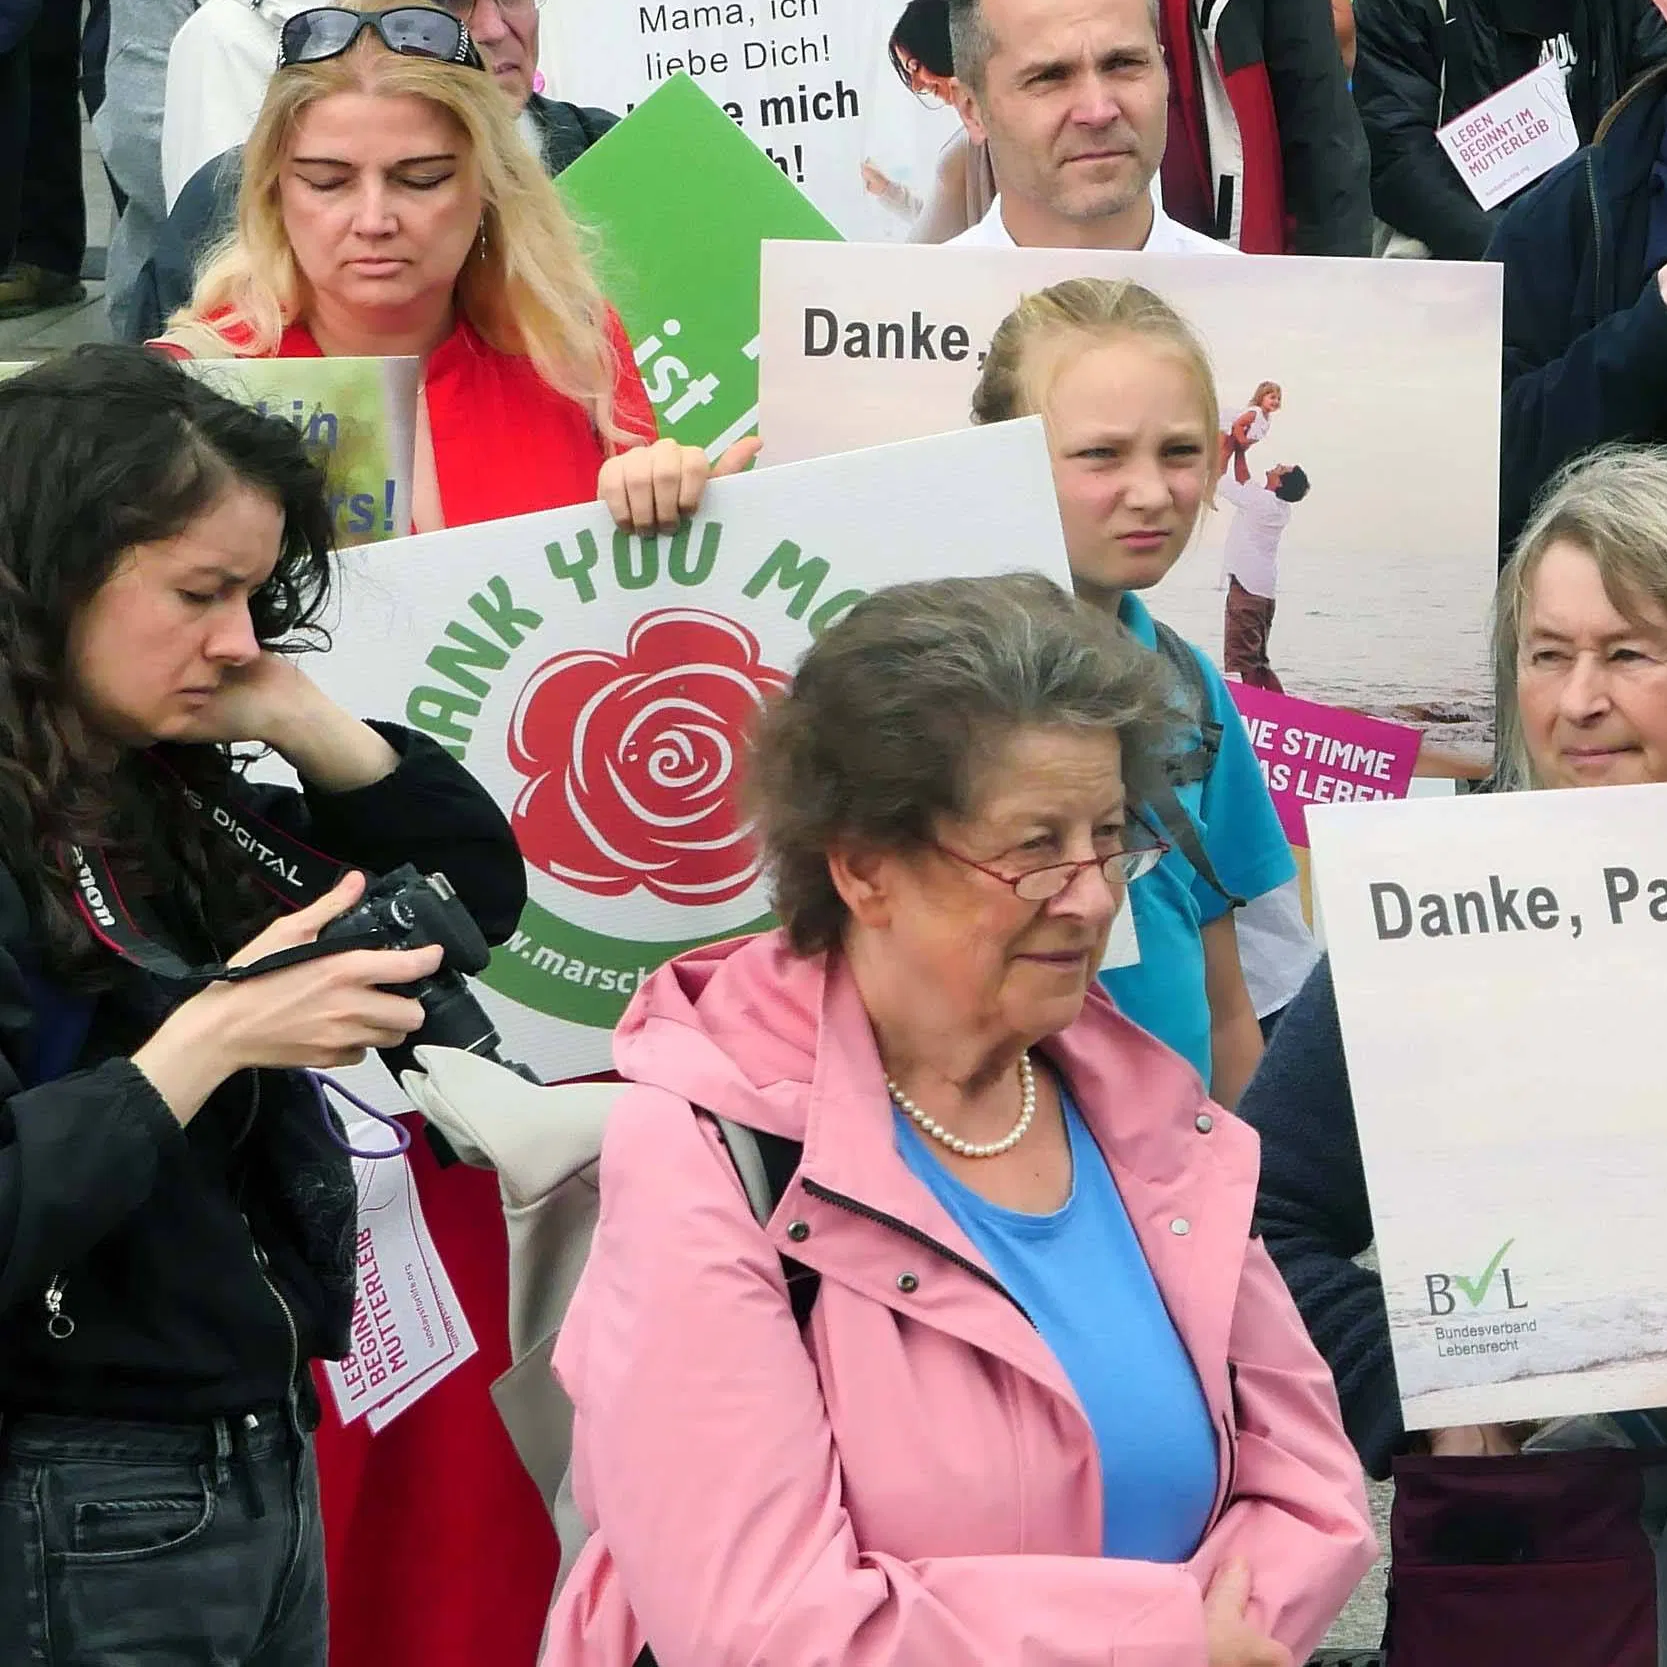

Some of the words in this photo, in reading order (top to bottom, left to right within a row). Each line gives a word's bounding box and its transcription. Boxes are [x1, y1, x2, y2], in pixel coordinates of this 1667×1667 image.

[638, 2, 755, 35] Mama,
[645, 48, 729, 82] liebe
[743, 33, 831, 71] Dich!
[759, 79, 861, 128] mich
[1449, 111, 1495, 150] LEBEN
[1458, 119, 1517, 164] BEGINNT
[1514, 107, 1535, 128] IM
[1467, 118, 1551, 179] MUTTERLEIB
[802, 307, 988, 372] Danke,
[543, 521, 723, 605] YOU
[1281, 727, 1397, 782] STIMME
[211, 805, 304, 887] DIGITAL
[1369, 873, 1583, 942] Danke,
[357, 1227, 409, 1376] MUTTERLEIB
[1433, 1317, 1538, 1341] Bundesverband
[1437, 1338, 1520, 1358] Lebensrecht
